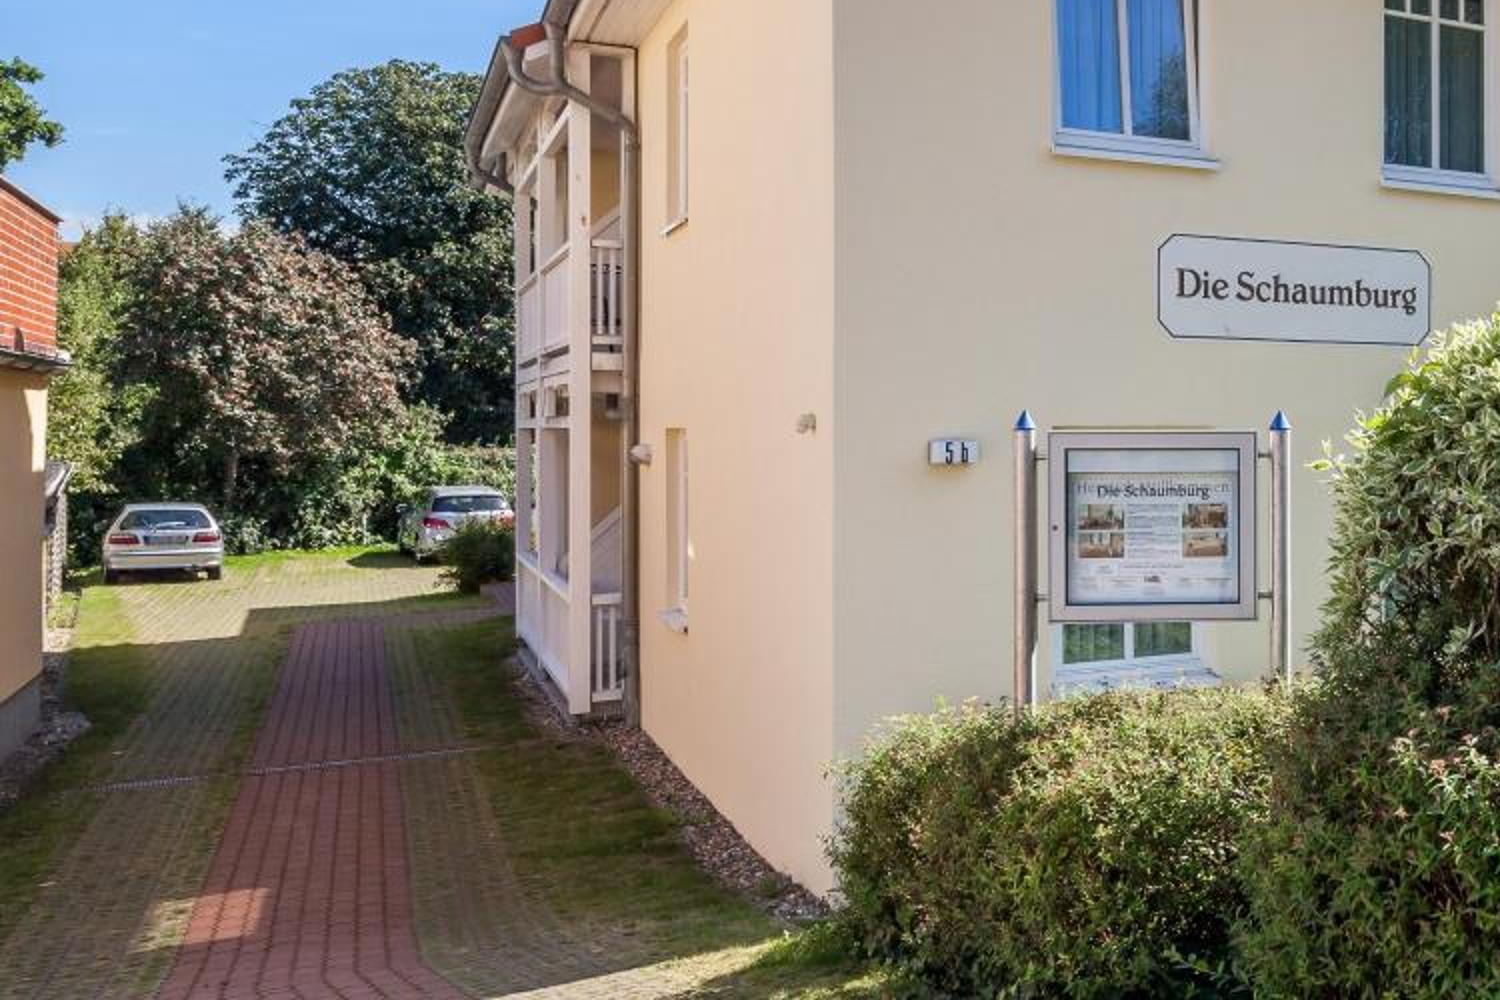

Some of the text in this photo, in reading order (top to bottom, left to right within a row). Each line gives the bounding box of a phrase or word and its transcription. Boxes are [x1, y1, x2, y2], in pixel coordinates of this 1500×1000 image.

[1175, 267, 1418, 316] Die Schaumburg
[1097, 484, 1120, 499] Die
[1123, 481, 1211, 500] Schaumburg
